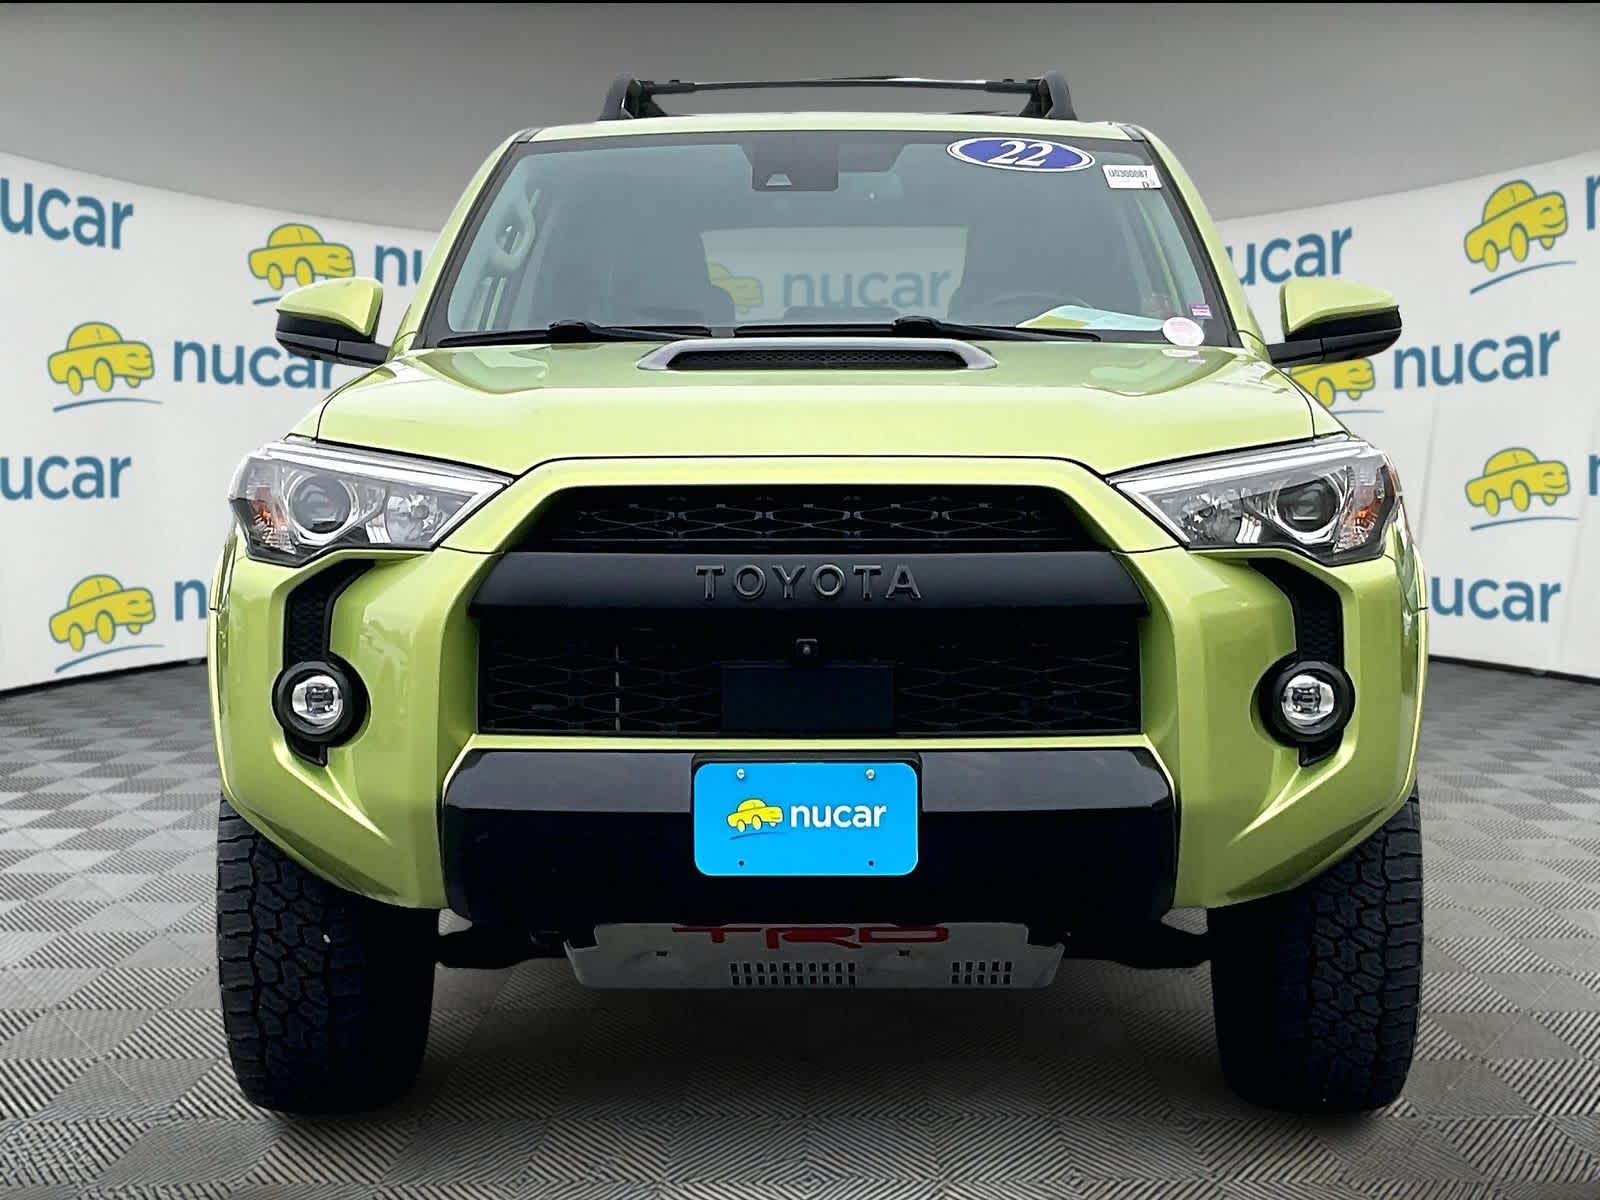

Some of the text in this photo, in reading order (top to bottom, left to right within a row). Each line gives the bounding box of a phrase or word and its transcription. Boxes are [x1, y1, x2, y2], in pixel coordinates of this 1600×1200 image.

[987, 139, 1052, 167] 22
[0, 178, 133, 249] ucar
[1225, 227, 1352, 285] ucar
[784, 271, 951, 307] nucar
[174, 341, 335, 388] nucar
[1393, 331, 1560, 389] nucar
[0, 456, 131, 500] ucar
[695, 563, 922, 600] TOYOTA
[1431, 577, 1561, 622] ucar
[790, 801, 887, 829] nucar
[672, 924, 949, 950] TRD
